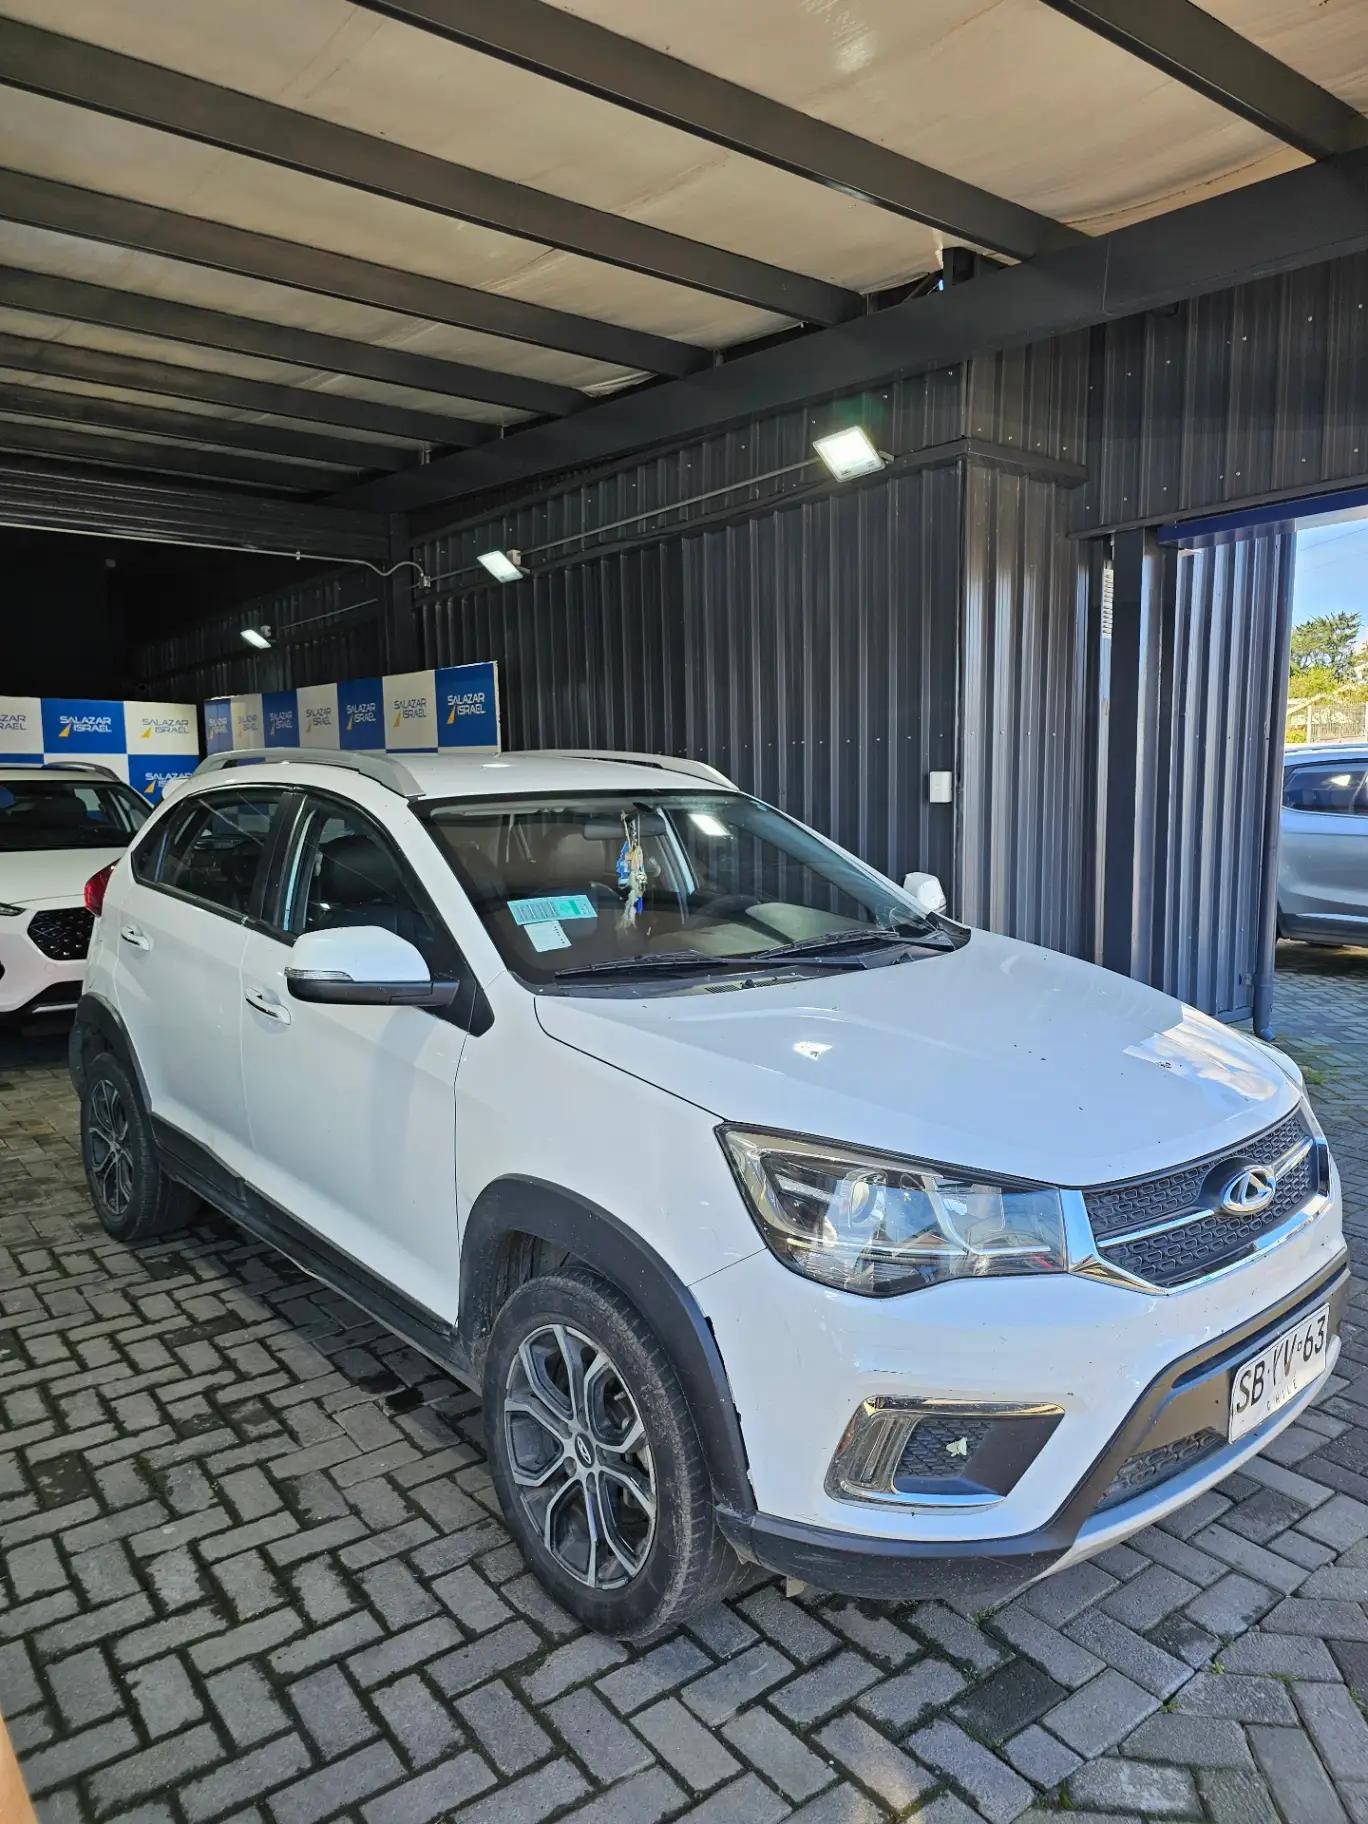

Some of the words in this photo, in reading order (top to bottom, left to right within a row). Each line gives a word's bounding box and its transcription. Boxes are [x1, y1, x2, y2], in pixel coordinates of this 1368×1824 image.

[393, 698, 427, 710] SALAZAR
[447, 692, 486, 706] SALAZAR
[346, 702, 376, 714] SALAZAR
[402, 708, 427, 719] ISRAEL
[457, 703, 487, 716] ISRAEL
[0, 714, 26, 722] ZAR
[59, 715, 112, 725] SALAZAR
[142, 718, 189, 726] SALAZAR
[354, 712, 377, 723] ISRAEL
[73, 724, 112, 733] ISRAEL
[154, 726, 190, 734] ISRAEL
